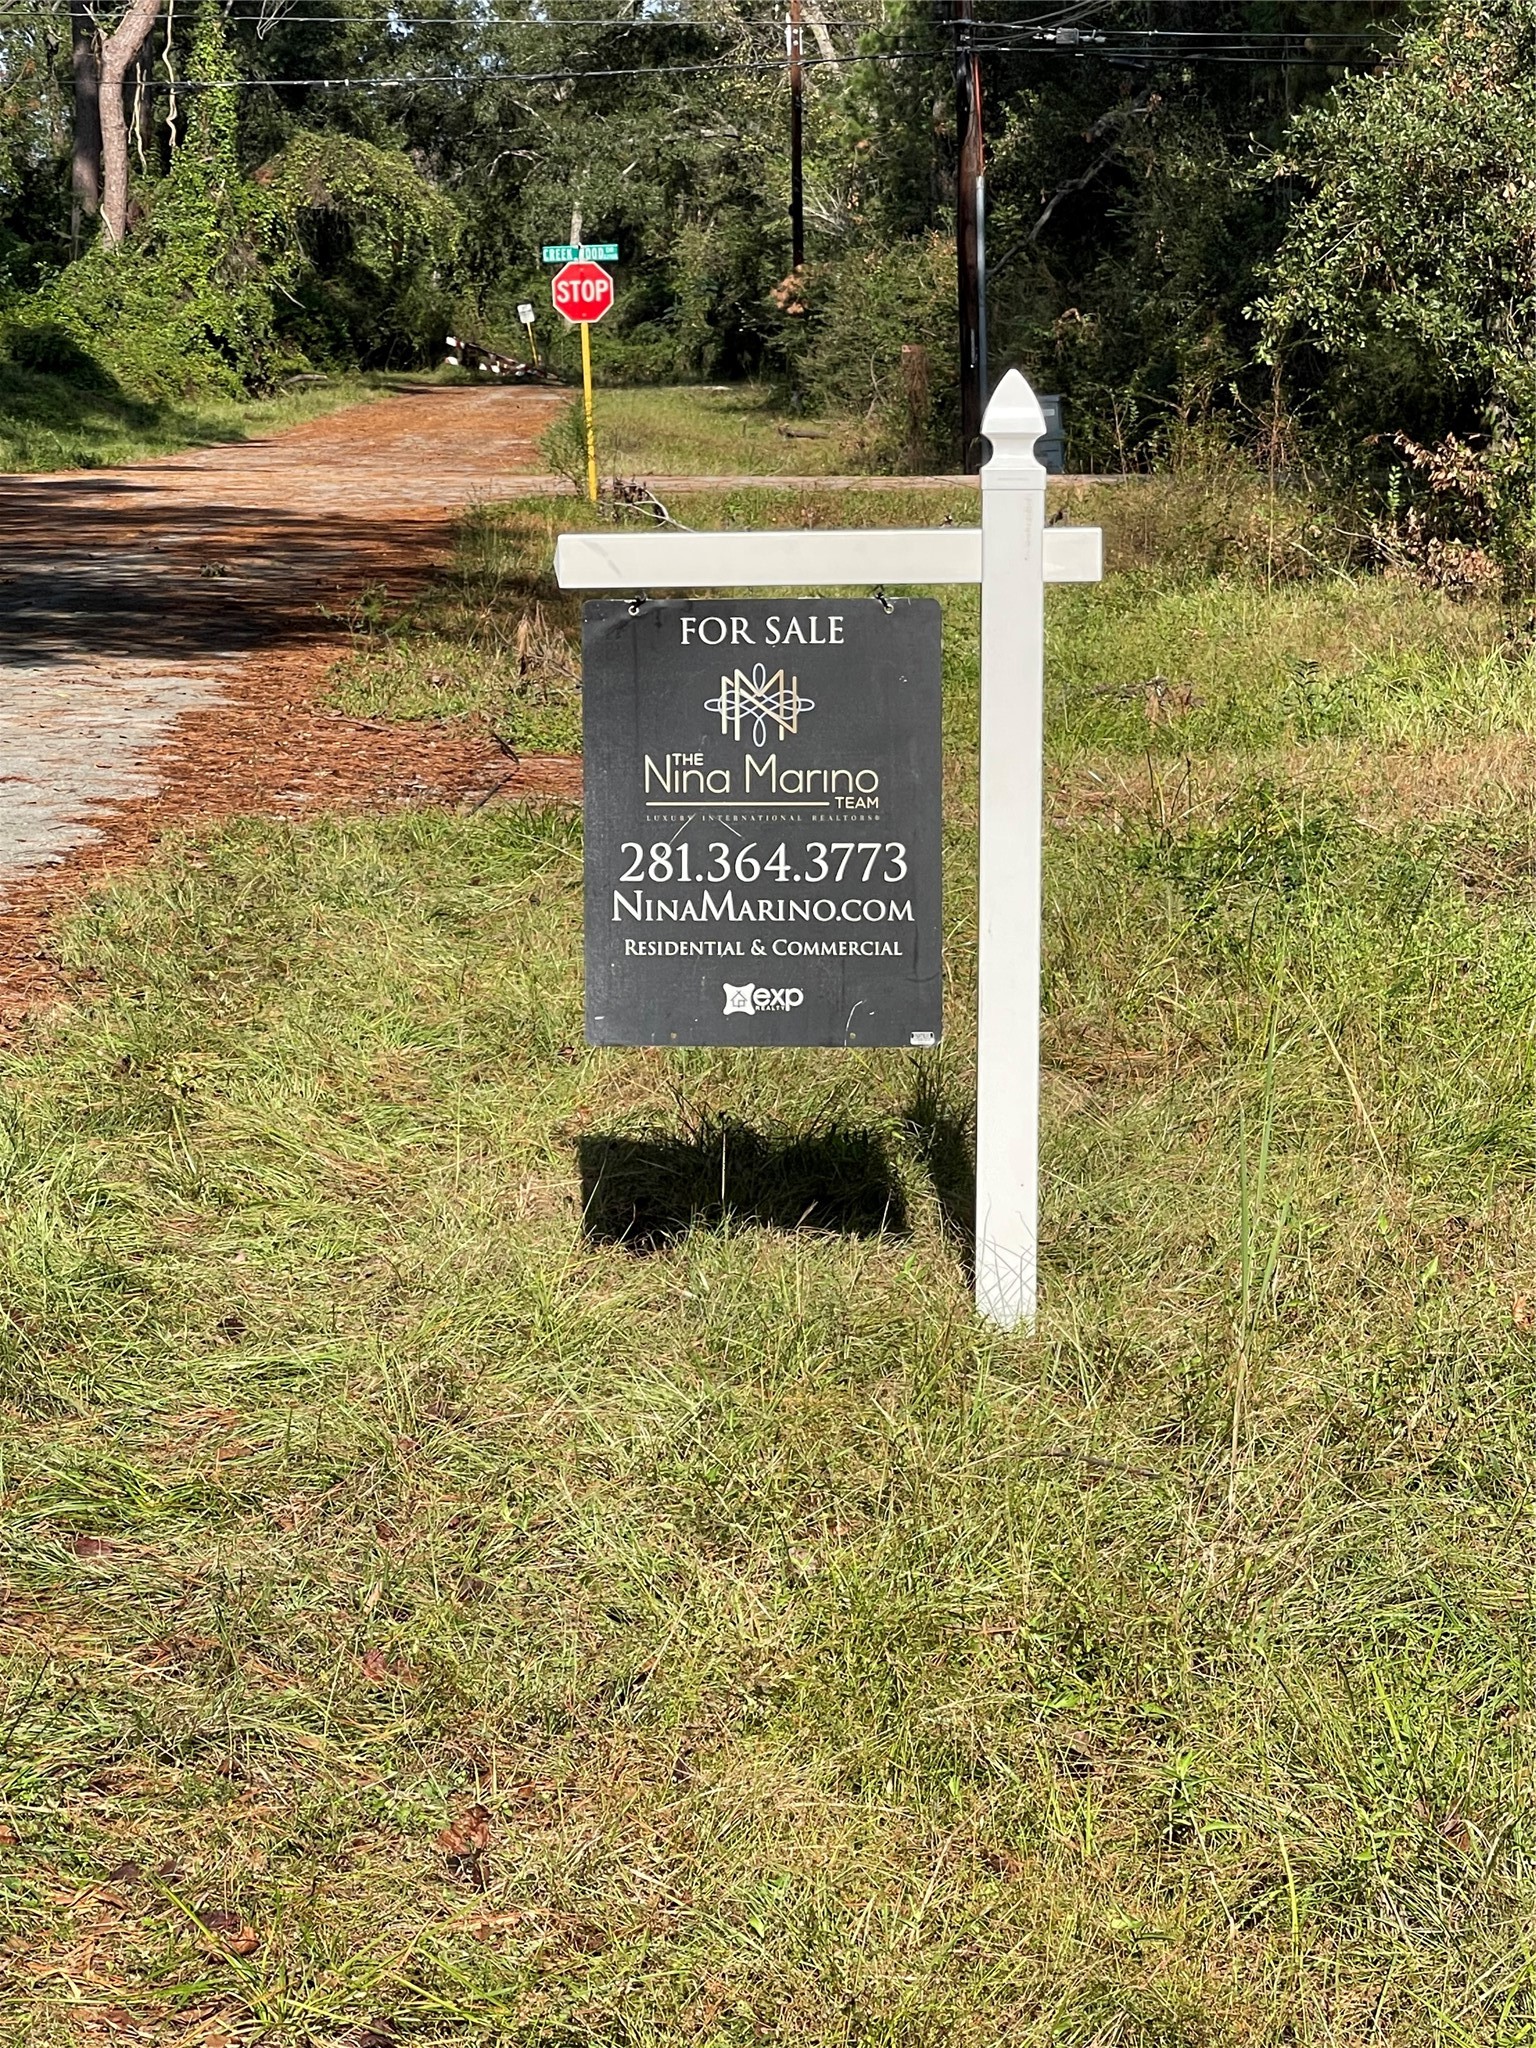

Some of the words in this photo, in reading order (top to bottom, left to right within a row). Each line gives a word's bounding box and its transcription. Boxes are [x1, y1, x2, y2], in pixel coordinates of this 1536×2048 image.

[543, 248, 573, 262] CREEK
[556, 279, 609, 303] STOP
[680, 616, 756, 645] FOR
[765, 615, 845, 645] SALE
[672, 753, 704, 766] THE
[644, 754, 731, 794] Nina
[745, 754, 880, 794] Marino
[834, 797, 880, 810] TEAM
[646, 814, 695, 822] LUXURY
[701, 814, 803, 822] INTERNATIONAL
[619, 841, 908, 882] 281.364.3773
[751, 938, 767, 957] &
